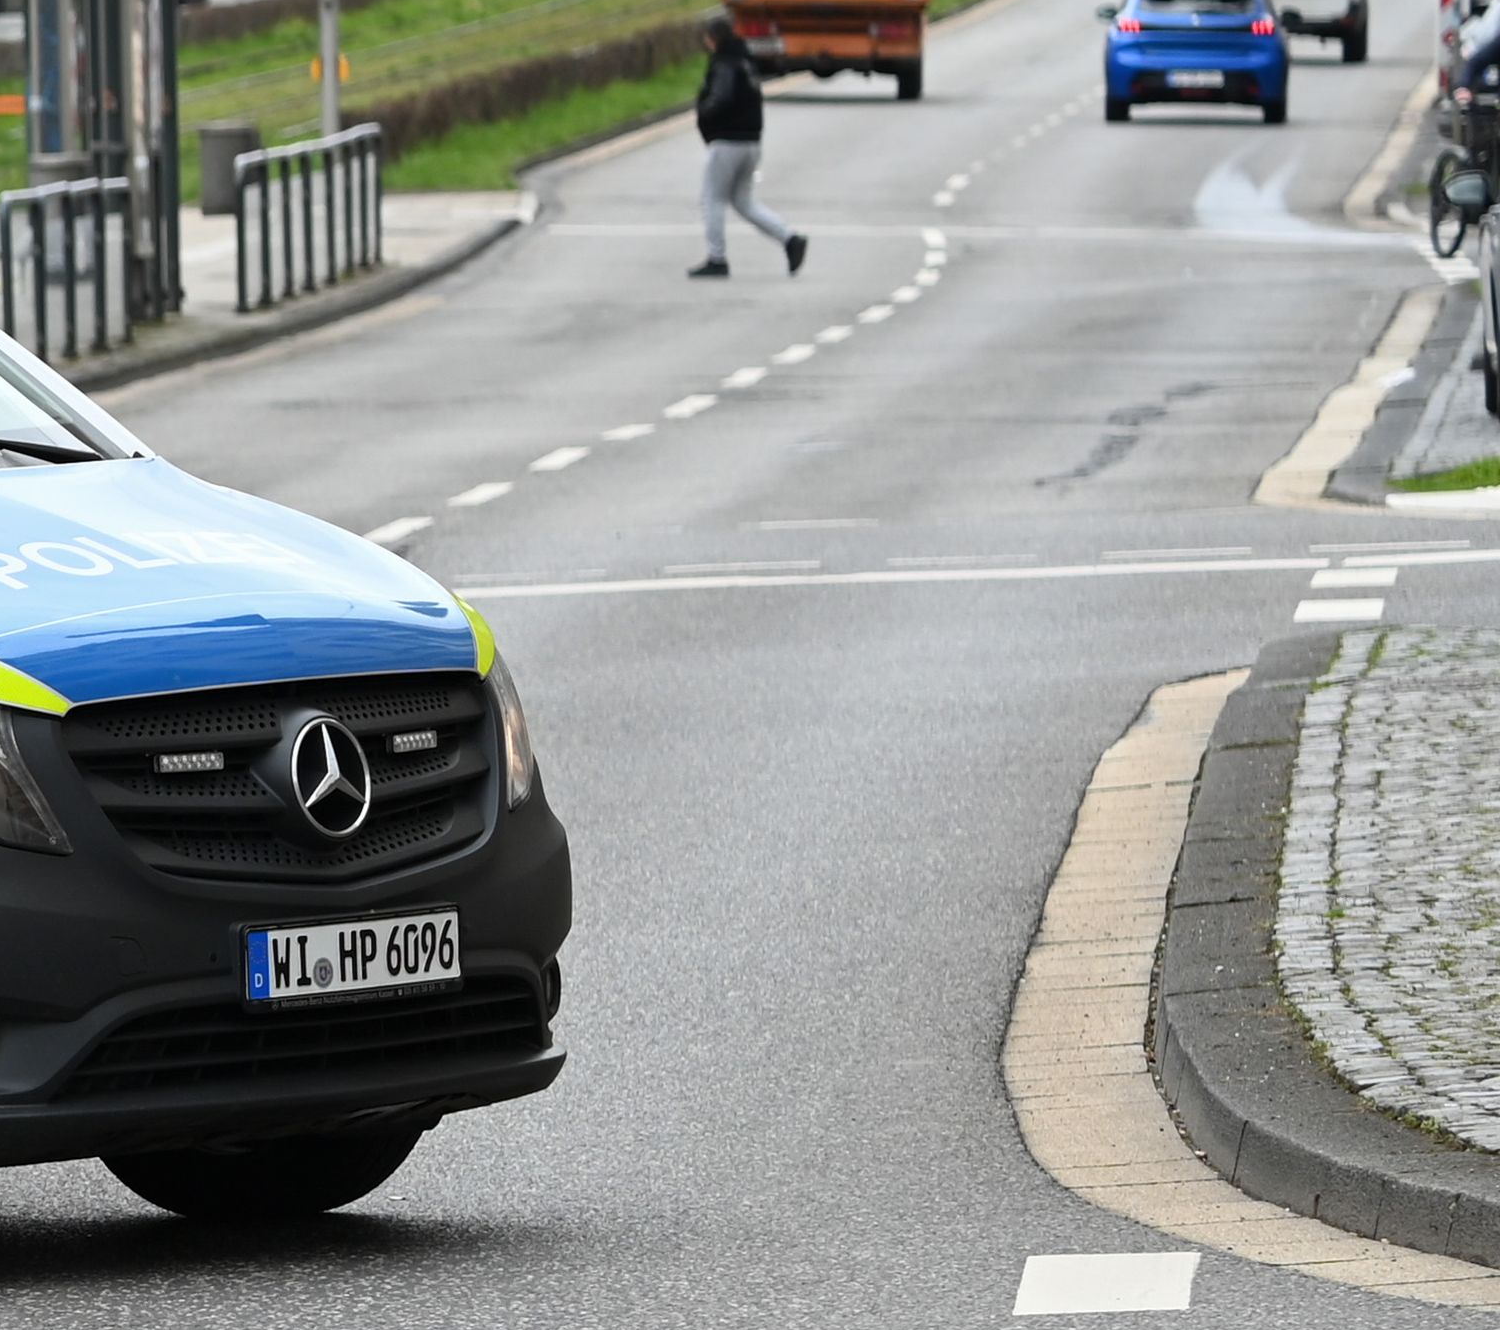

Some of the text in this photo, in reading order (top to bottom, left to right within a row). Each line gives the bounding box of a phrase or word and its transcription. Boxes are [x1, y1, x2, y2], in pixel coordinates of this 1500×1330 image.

[254, 919, 455, 989] D WI HP 6096
